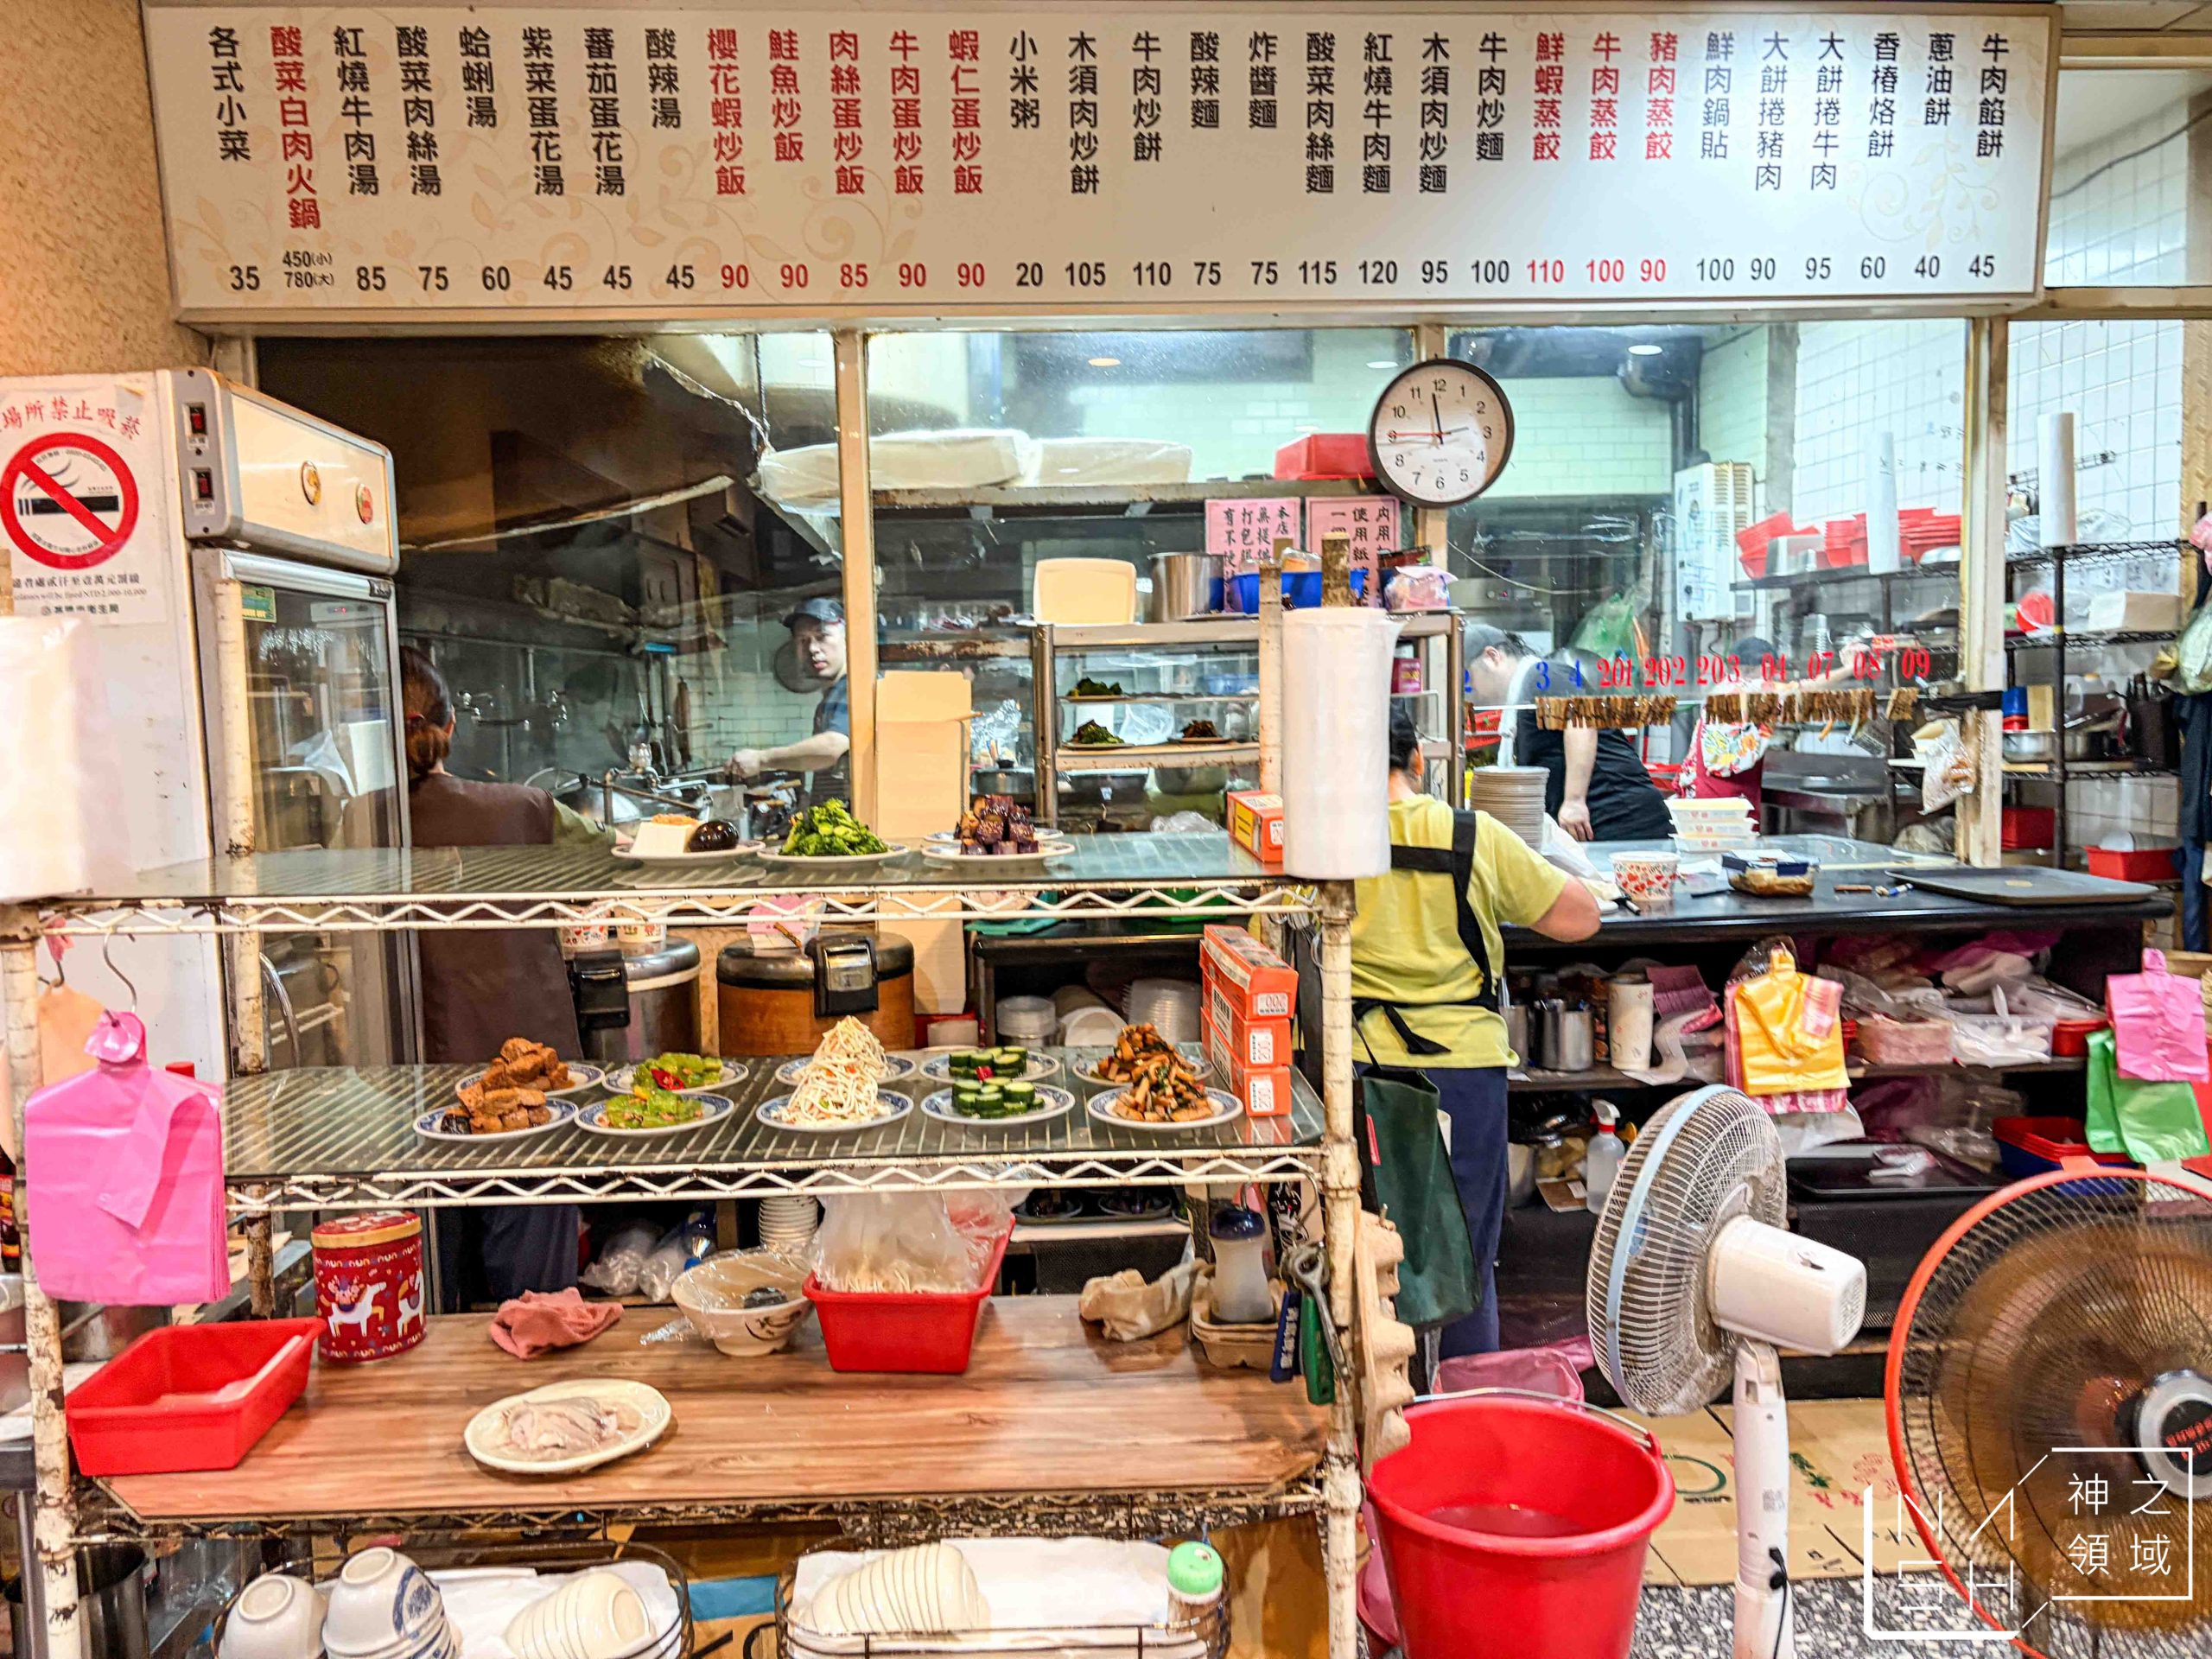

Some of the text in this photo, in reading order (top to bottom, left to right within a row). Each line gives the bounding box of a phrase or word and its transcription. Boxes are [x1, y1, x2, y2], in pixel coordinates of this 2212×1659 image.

[459, 26, 497, 128] 蛤蜊湯
[645, 28, 681, 129] 酸辣湯
[1010, 30, 1039, 129] 小米粥
[1191, 31, 1219, 129] 酸辣麵
[1249, 31, 1278, 129] 炸醬麵
[208, 26, 251, 161] 各式小菜
[769, 29, 804, 162] 鮭魚炒飯
[1132, 30, 1162, 162] 牛肉炒餅
[1476, 32, 1507, 161] 牛肉炒麵
[1533, 32, 1564, 161] 鮮蝦蒸餃
[1590, 32, 1620, 160] 牛肉蒸餃
[1646, 32, 1677, 159] 豬肉蒸餃
[1701, 32, 1733, 159] 鮮肉鍋貼
[1976, 33, 2009, 157] 牛肉餡餅
[334, 26, 378, 195] 紅燒牛肉湯
[396, 26, 441, 196] 酸菜肉絲湯
[522, 27, 564, 196] 紫菜蛋花湯
[584, 27, 625, 196] 蕃茄蛋花湯
[708, 29, 746, 194] 櫻花蝦炒飯
[830, 30, 865, 194] 肉絲蛋炒飯
[889, 30, 924, 194] 牛肉蛋炒飯
[949, 30, 982, 194] 蝦仁蛋炒飯
[1069, 31, 1099, 194] 木須肉炒餅
[1306, 32, 1335, 194] 酸菜肉絲麵
[1363, 32, 1393, 194] 紅燒牛肉麵
[1419, 32, 1450, 194] 木須肉炒麵
[1756, 31, 1789, 191] 大餅捲豬肉
[1811, 31, 1845, 190] 大餅捲牛肉
[270, 26, 321, 229] 酸菜白肉火鍋
[230, 265, 260, 290] 35
[357, 266, 385, 291] 85
[418, 266, 448, 291] 75
[482, 266, 511, 291] 60
[543, 266, 572, 290] 45
[603, 265, 632, 289] 45
[666, 264, 694, 289] 45
[721, 264, 748, 289] 90
[781, 264, 808, 288] 90
[841, 264, 868, 288] 85
[899, 264, 926, 287] 90
[957, 263, 984, 287] 90
[1016, 263, 1043, 287] 20
[1065, 262, 1105, 286] 105
[1134, 262, 1171, 286] 110
[1194, 262, 1221, 285] 75
[1251, 262, 1278, 285] 75
[1299, 261, 1337, 284] 115
[1359, 260, 1397, 284] 120
[1422, 260, 1448, 283] 95
[1471, 260, 1510, 283] 100
[1528, 260, 1564, 283] 110
[1586, 259, 1624, 283] 100
[1641, 259, 1666, 282] 90
[1697, 258, 1734, 281] 100
[1751, 258, 1776, 281] 90
[1806, 257, 1831, 280] 95
[1861, 257, 1885, 279] 60
[1915, 256, 1940, 278] 40
[1968, 255, 1994, 277] 45
[1409, 386, 1421, 400] 11
[1433, 378, 1446, 392] 12
[1460, 384, 1465, 397] 1
[1391, 405, 1406, 419] 10
[1476, 400, 1485, 415] 2
[1483, 425, 1492, 440] 3
[1395, 454, 1404, 467] 8
[1476, 450, 1485, 463] 4
[1412, 471, 1421, 486] 7
[1435, 476, 1445, 490] 6
[1459, 469, 1469, 483] 5
[1535, 661, 1551, 691] 3
[1569, 658, 1583, 689] 4
[1597, 657, 1634, 689] 201
[1644, 656, 1686, 687] 202
[1695, 653, 1741, 686] 203
[1807, 650, 1834, 681] 07
[1853, 648, 1882, 681] 08
[1901, 646, 1930, 679] 09
